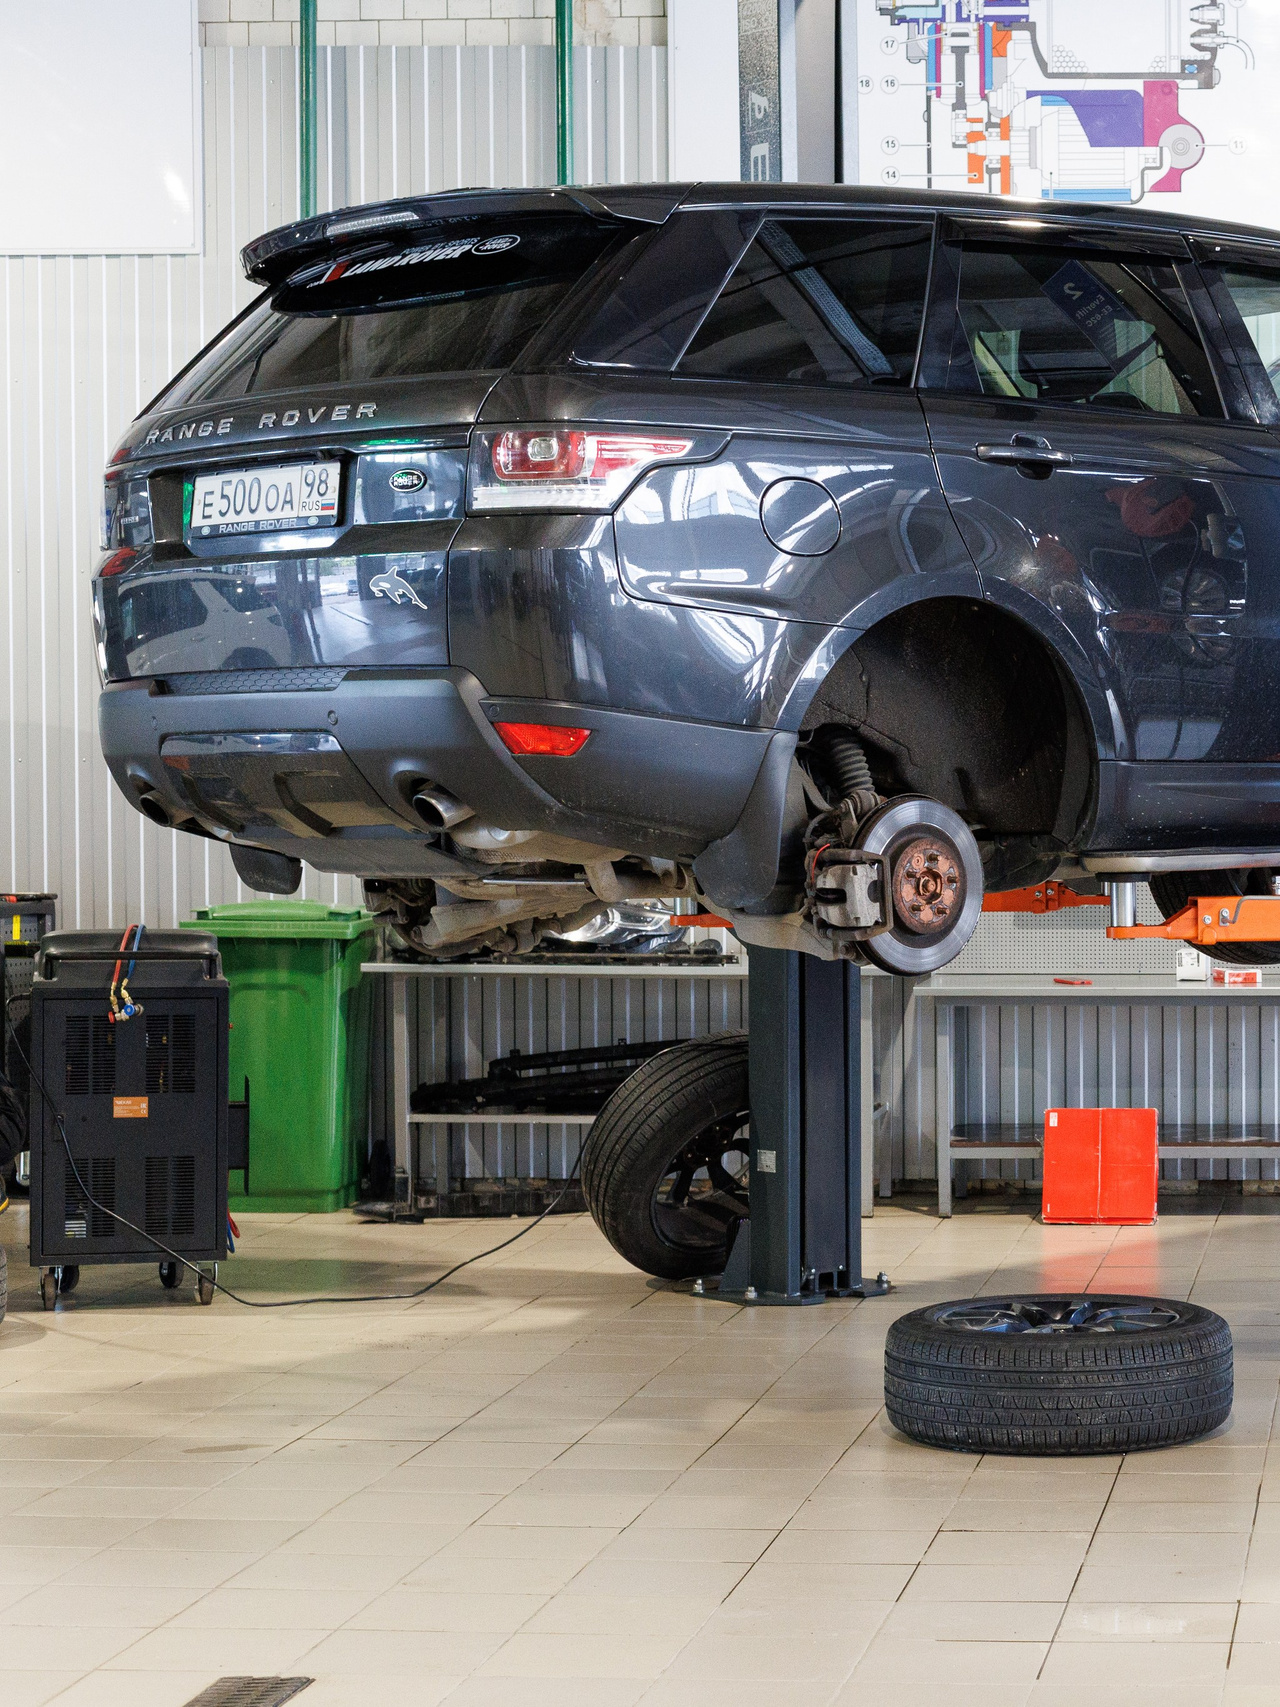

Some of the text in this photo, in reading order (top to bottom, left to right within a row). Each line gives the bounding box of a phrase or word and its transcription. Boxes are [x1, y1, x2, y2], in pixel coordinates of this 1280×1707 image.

[885, 40, 895, 48] 17
[860, 80, 870, 88] 18
[885, 80, 895, 88] 16
[886, 140, 896, 148] 15
[886, 171, 896, 179] 14
[340, 244, 473, 278] LAND ROVER
[146, 402, 378, 446] RANGE ROVER
[304, 468, 329, 498] 98
[301, 500, 321, 512] RUS
[219, 519, 297, 534] RANGE ROVER
